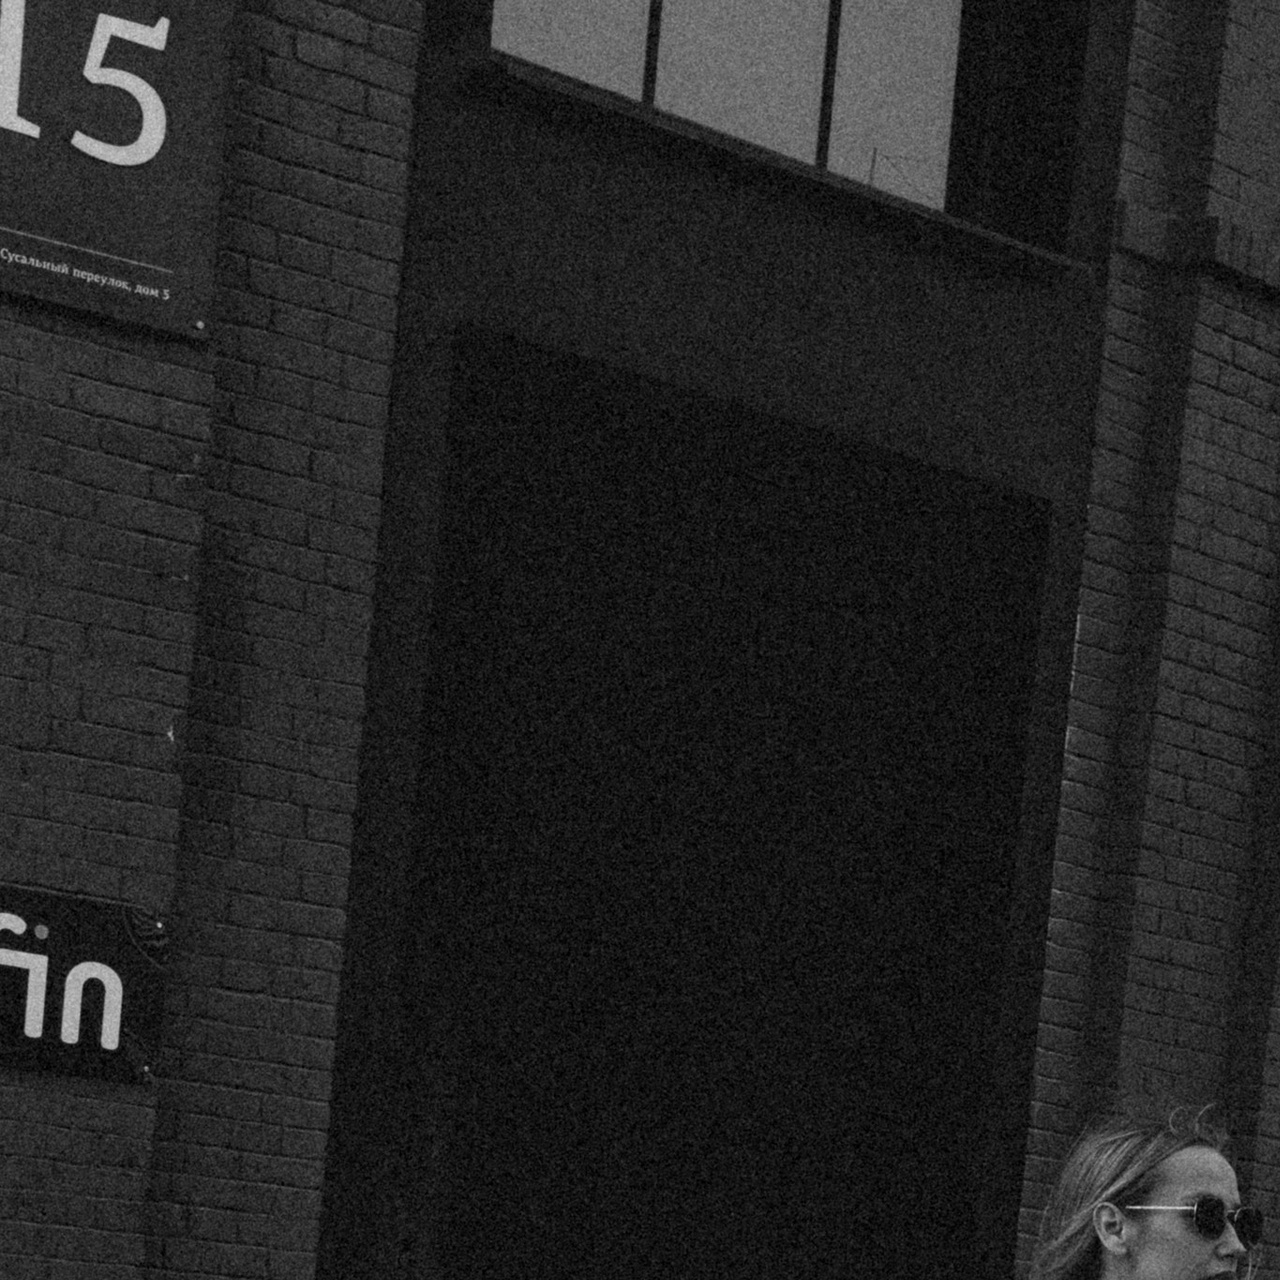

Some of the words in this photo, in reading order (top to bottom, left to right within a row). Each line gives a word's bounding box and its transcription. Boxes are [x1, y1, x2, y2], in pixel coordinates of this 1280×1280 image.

[0, 247, 69, 276] Сусальный
[73, 267, 131, 292] переулок,
[134, 283, 160, 298] дом
[162, 288, 171, 300] 5
